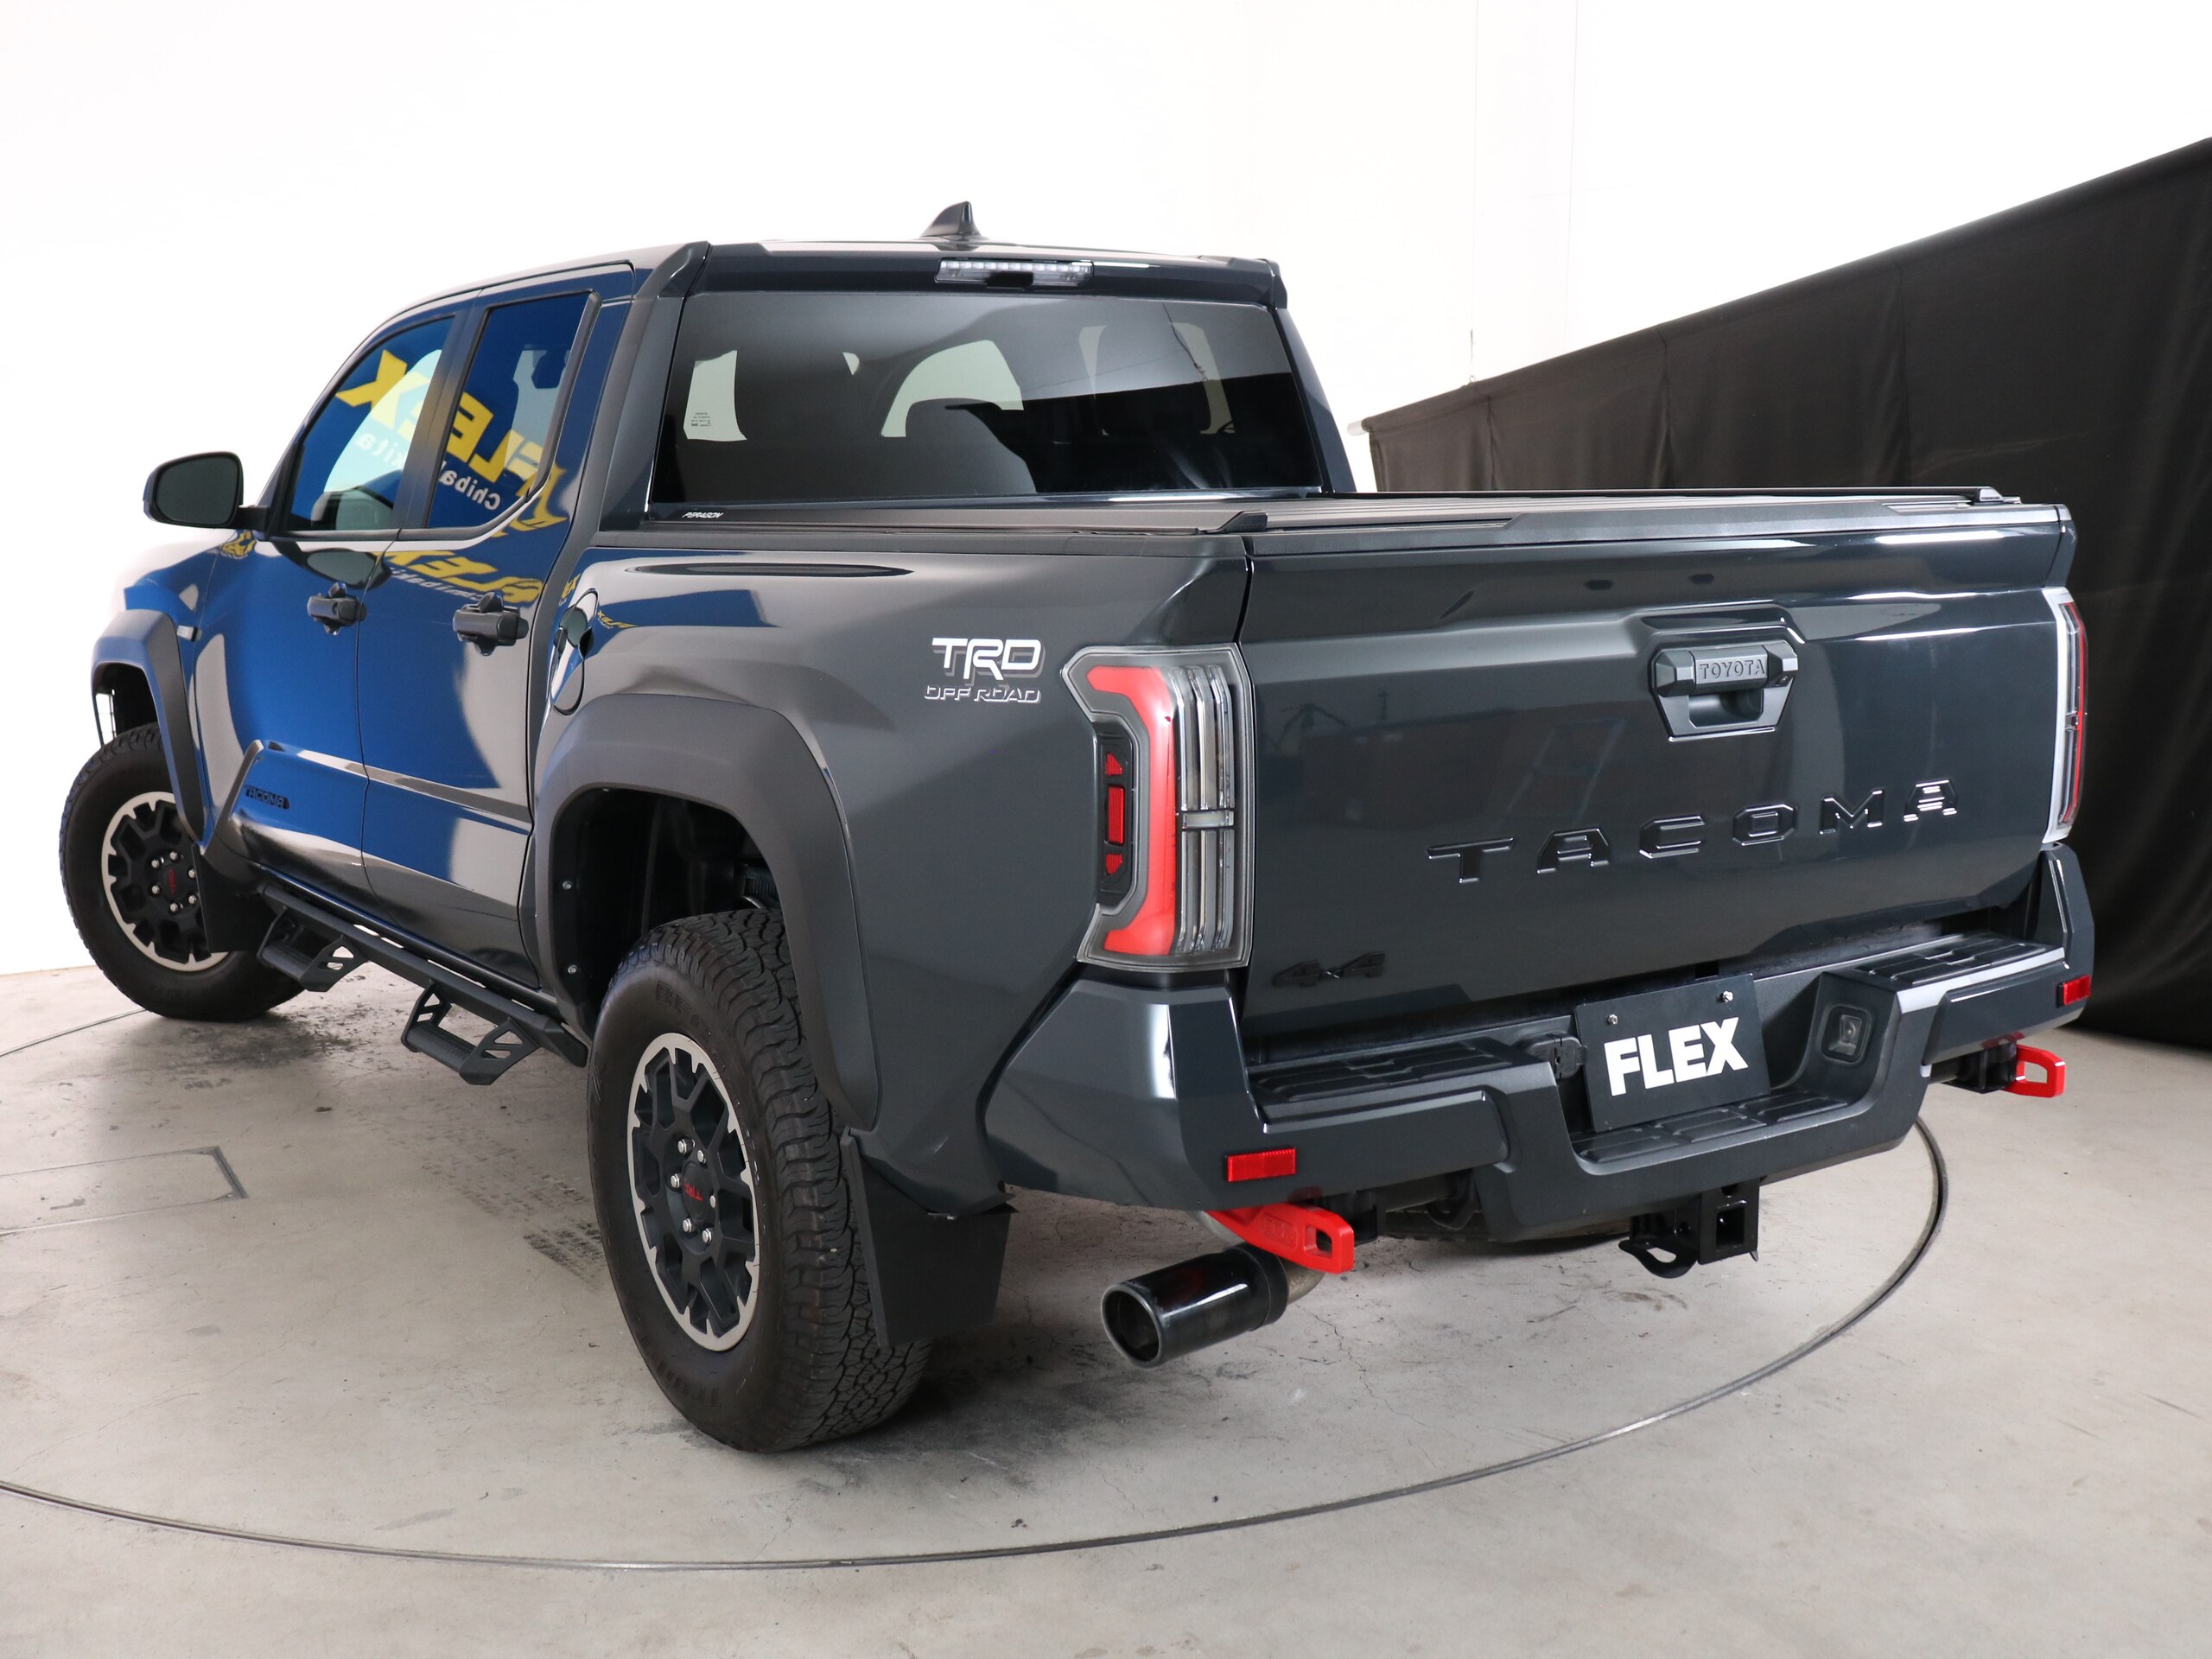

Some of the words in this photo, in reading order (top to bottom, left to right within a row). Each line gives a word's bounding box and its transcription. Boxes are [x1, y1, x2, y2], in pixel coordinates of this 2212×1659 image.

[931, 637, 1043, 682] TRD
[1699, 658, 1765, 680] TOYOTA
[924, 685, 972, 701] OFF
[973, 688, 1041, 704] ROAD
[243, 785, 283, 809] TACOMA
[1426, 779, 1958, 883] TACOMA
[1603, 1017, 1749, 1097] FLEX
